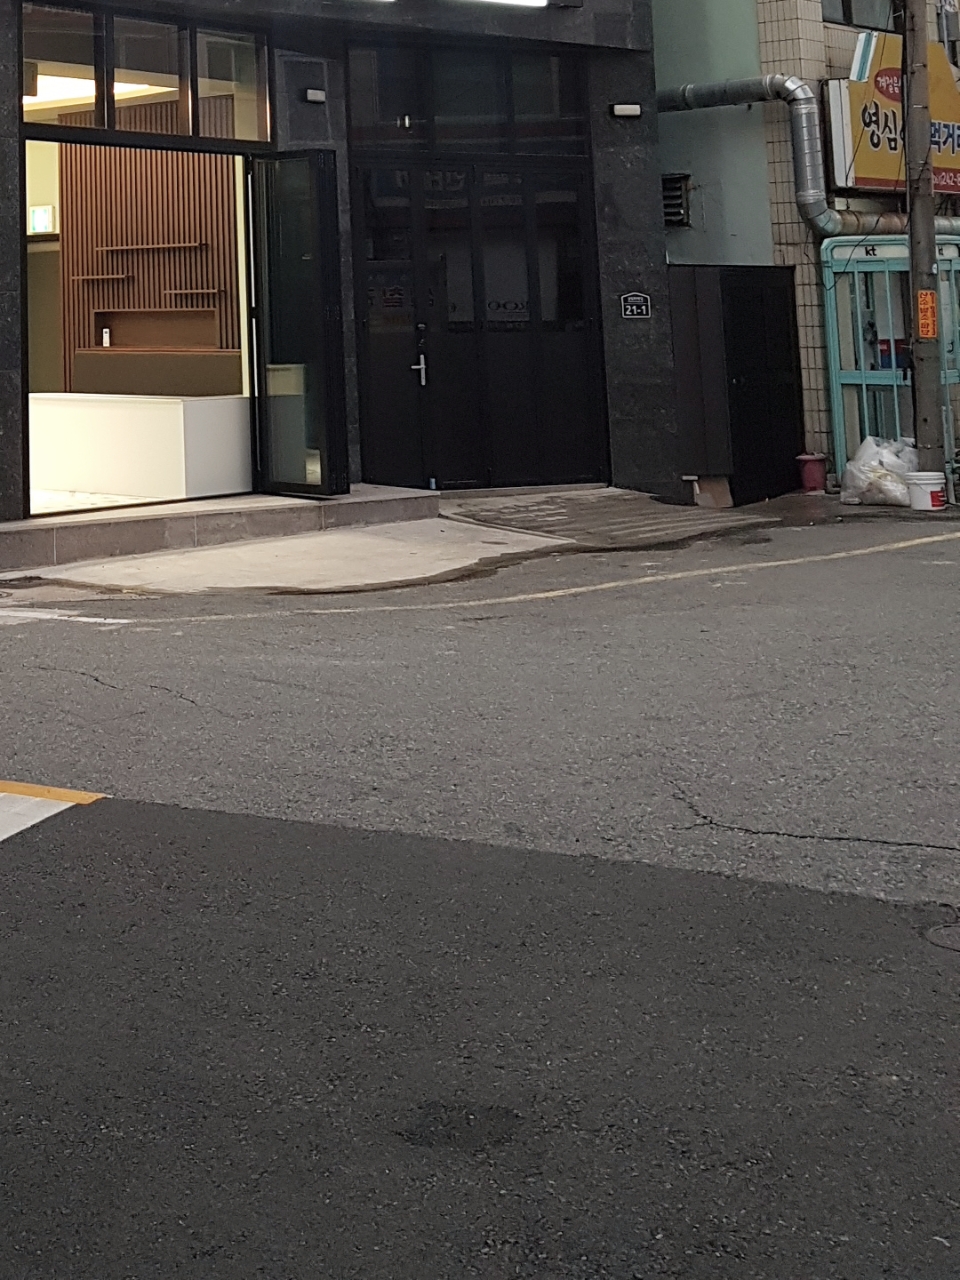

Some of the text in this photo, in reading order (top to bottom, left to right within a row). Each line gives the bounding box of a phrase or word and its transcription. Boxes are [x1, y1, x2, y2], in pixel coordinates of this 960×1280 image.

[861, 99, 960, 155] 영심 먹거
[865, 245, 877, 257] kt
[625, 305, 647, 315] 21-1
